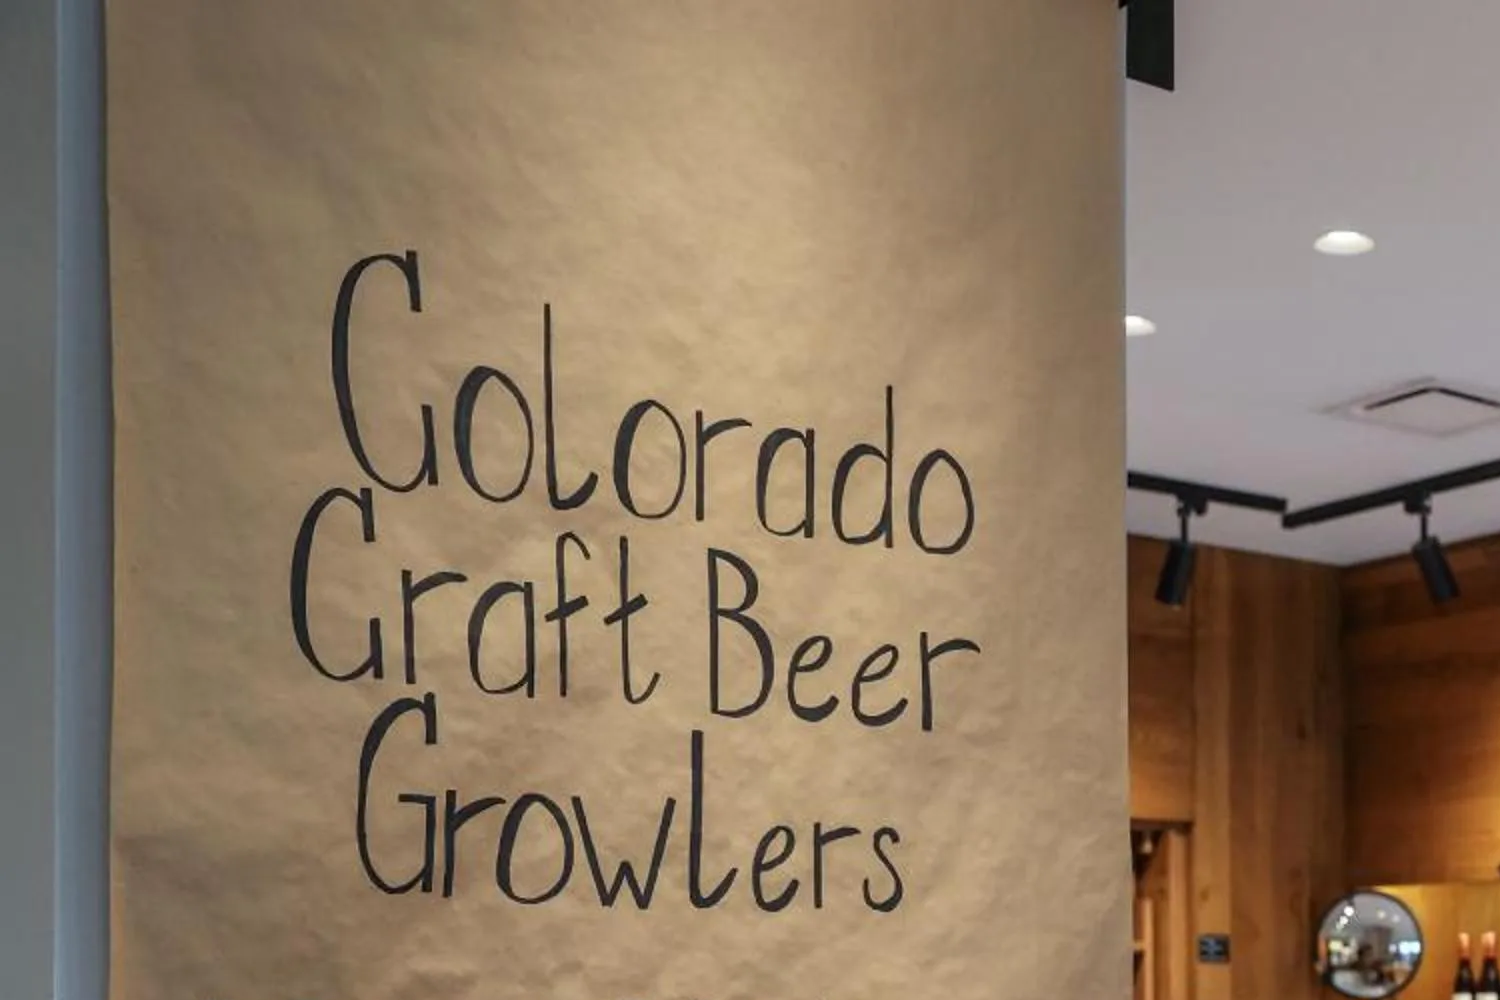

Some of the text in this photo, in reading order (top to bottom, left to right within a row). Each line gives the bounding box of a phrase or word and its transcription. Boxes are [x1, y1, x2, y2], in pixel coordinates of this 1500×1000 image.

[332, 250, 975, 555] Colorado
[290, 488, 981, 733] Craft Beer
[356, 692, 904, 913] Growlers
